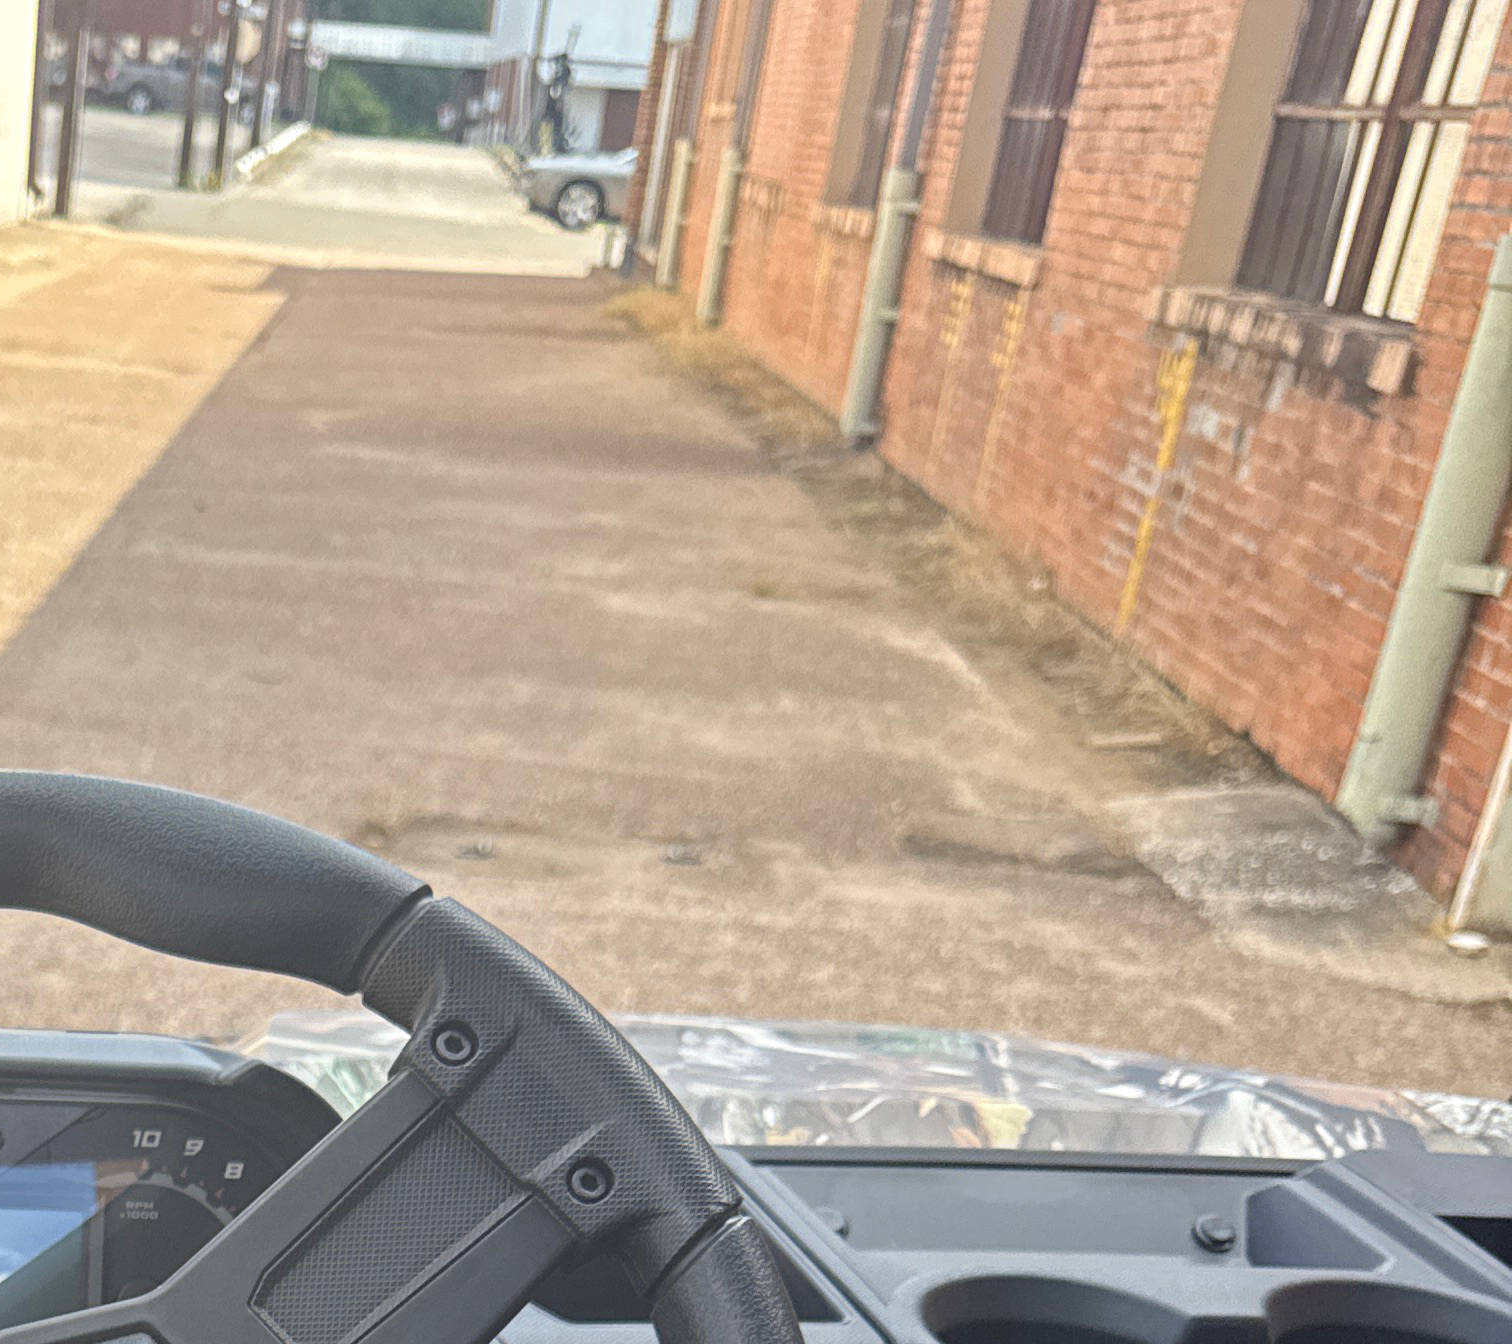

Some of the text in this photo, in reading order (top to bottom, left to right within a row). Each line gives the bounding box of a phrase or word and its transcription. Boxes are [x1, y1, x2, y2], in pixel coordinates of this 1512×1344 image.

[132, 1130, 162, 1149] 10
[184, 1139, 204, 1157] 9
[224, 1163, 245, 1180] 8
